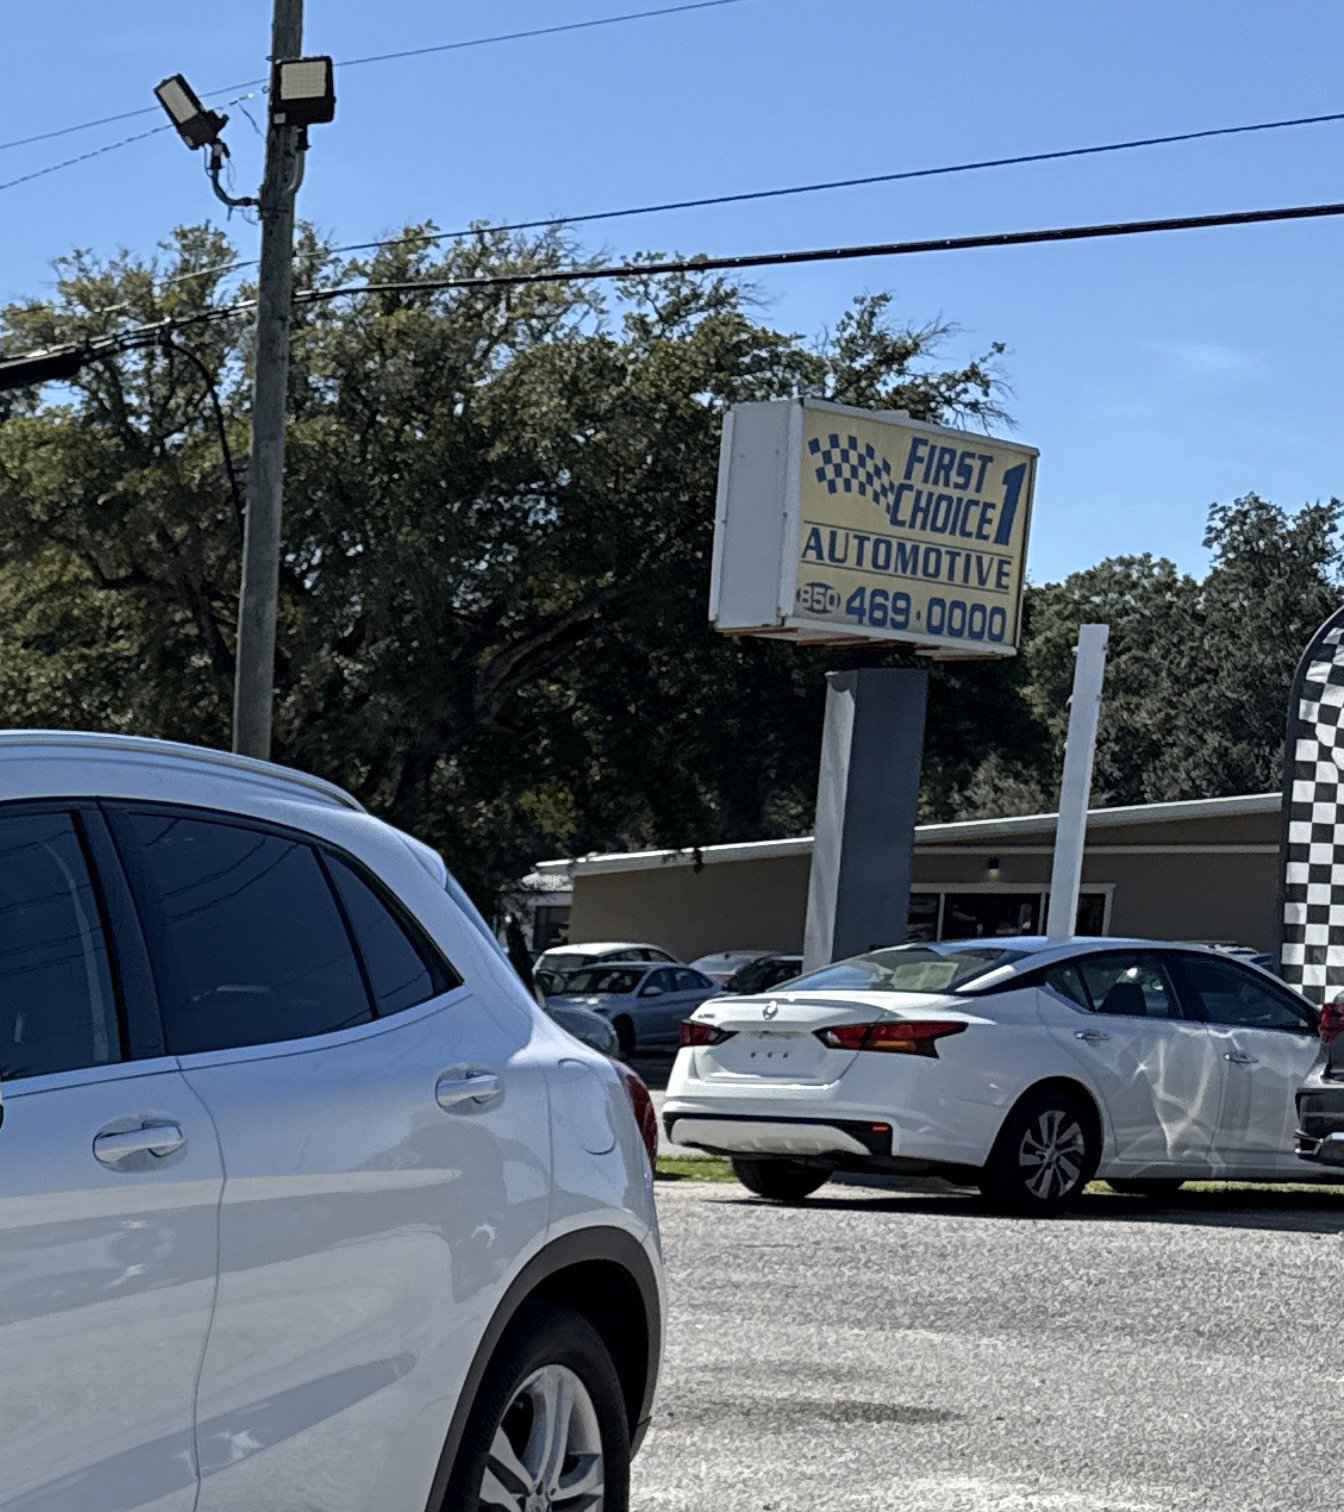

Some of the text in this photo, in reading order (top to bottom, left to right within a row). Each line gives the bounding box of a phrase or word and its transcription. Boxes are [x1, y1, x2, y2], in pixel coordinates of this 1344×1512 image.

[903, 437, 994, 494] FIRST
[889, 462, 1027, 546] CHOICE 1
[801, 527, 1012, 590] AUTOMOTIVE
